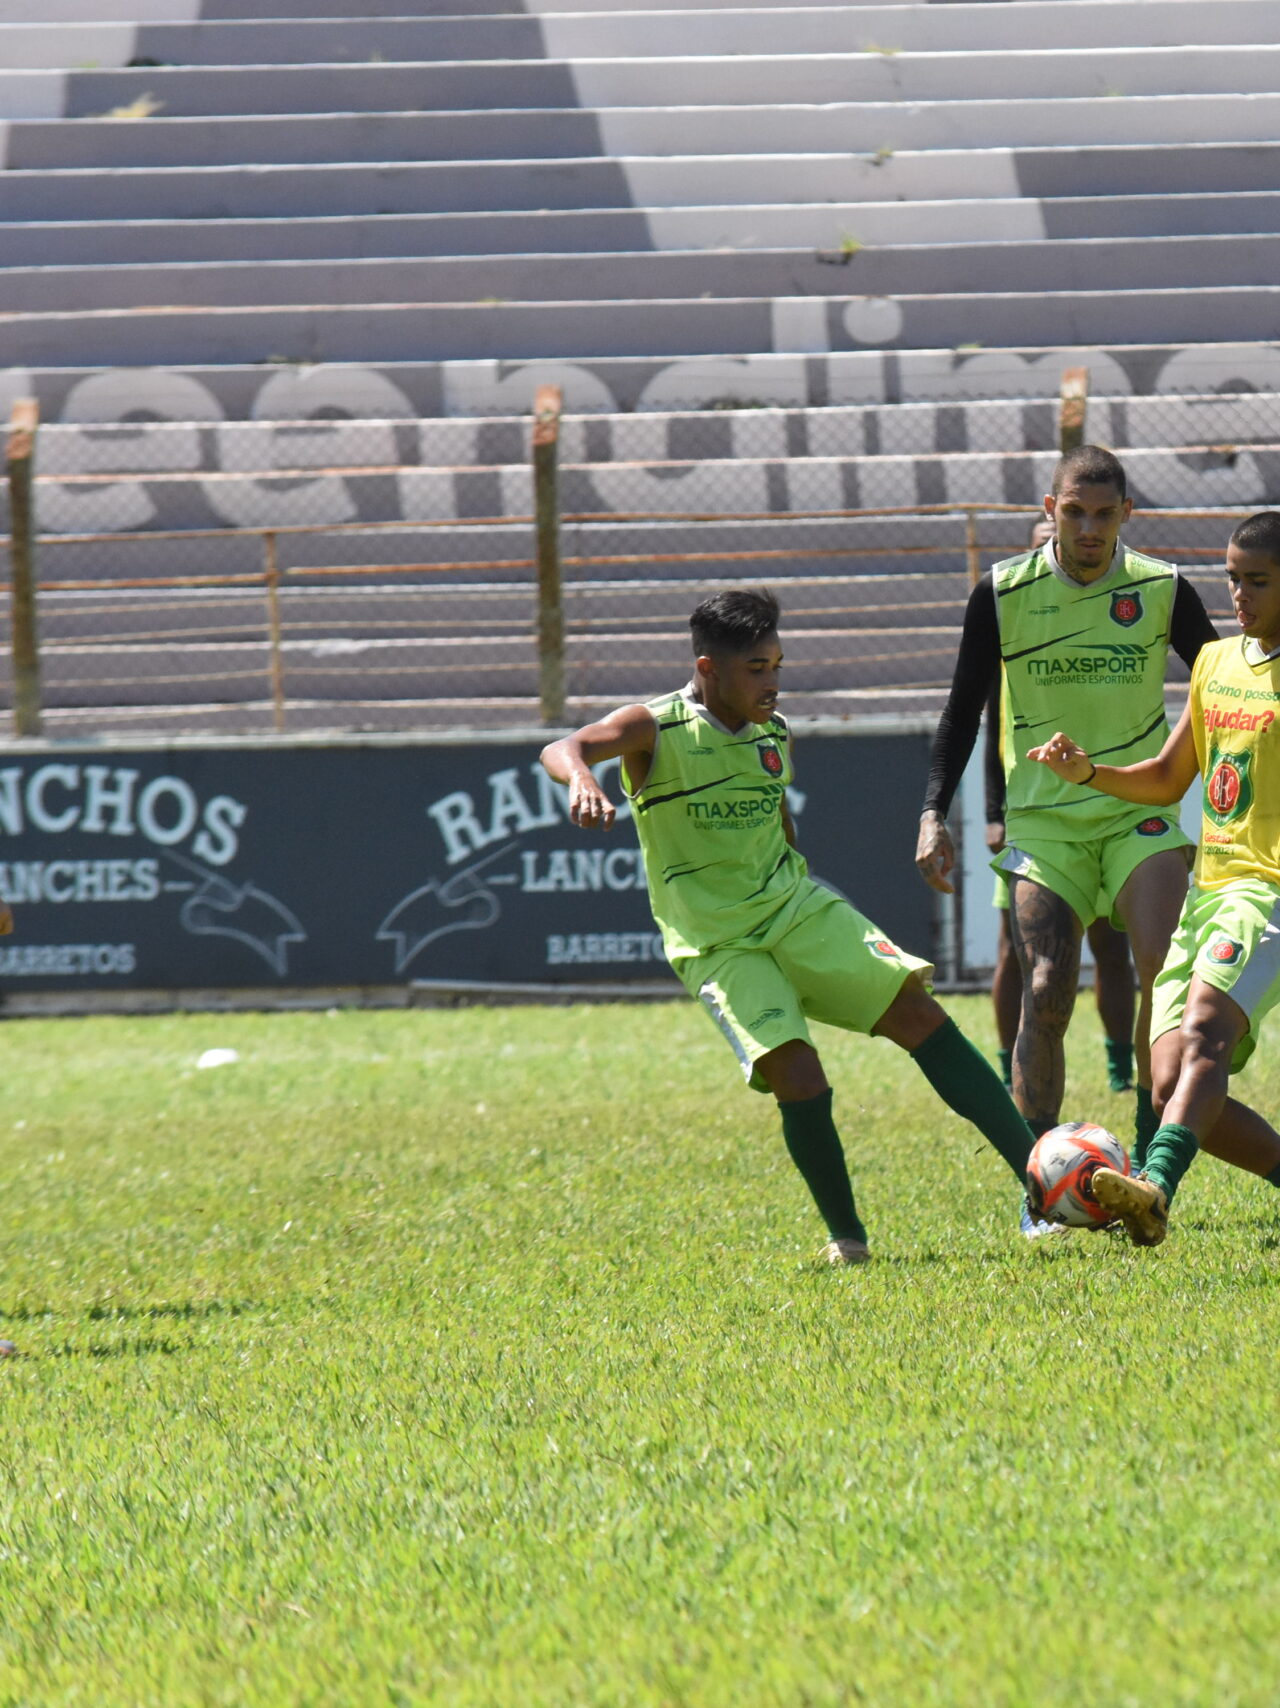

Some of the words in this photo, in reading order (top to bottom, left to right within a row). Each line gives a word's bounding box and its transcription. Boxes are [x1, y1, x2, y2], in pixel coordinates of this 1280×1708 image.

[1027, 656, 1149, 675] MAXSPORT
[1035, 675, 1087, 687] UNIFORMES
[1088, 674, 1143, 685] ESPORTIVOS
[1207, 680, 1242, 698] Como
[1204, 704, 1275, 733] ajudar?
[694, 819, 745, 831] UNIFORMES
